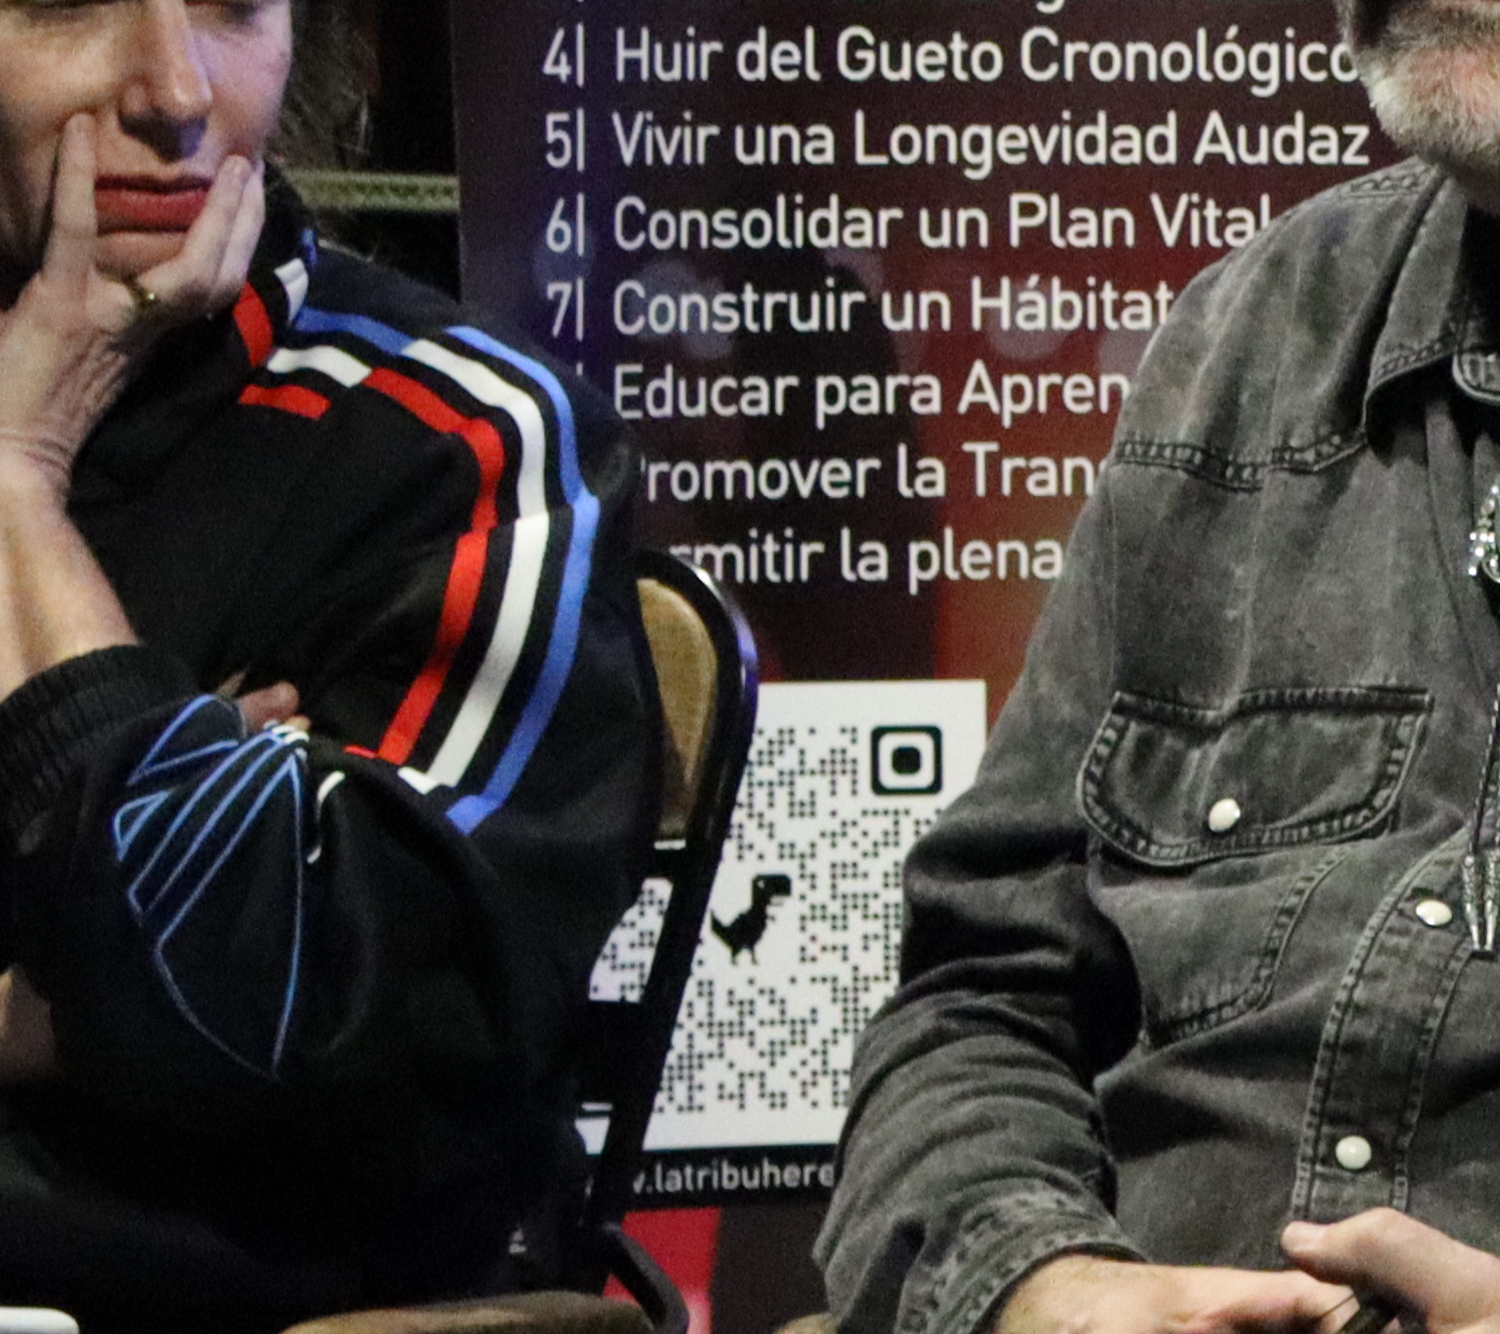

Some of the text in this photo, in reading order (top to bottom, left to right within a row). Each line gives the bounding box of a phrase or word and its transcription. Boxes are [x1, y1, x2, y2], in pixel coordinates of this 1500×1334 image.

[616, 26, 724, 82] Huir
[736, 25, 821, 82] del
[837, 25, 1004, 82] Gueto
[1020, 24, 1359, 98] Cronológico
[611, 110, 721, 166] Vivir
[734, 124, 835, 165] una
[854, 109, 1178, 181] Longevidad
[1193, 110, 1370, 165] Audaz
[614, 193, 904, 251] Consolidar
[919, 207, 989, 248] un
[1009, 192, 1135, 248] Plan
[1150, 192, 1273, 249] Vital
[613, 277, 867, 335] Construir
[881, 290, 951, 332] un
[971, 274, 1175, 331] Hábitat
[614, 363, 800, 420] Educar
[815, 373, 942, 430] para
[640, 441, 1109, 502] romover la Tran
[840, 527, 889, 582] la
[908, 530, 1065, 595] plena
